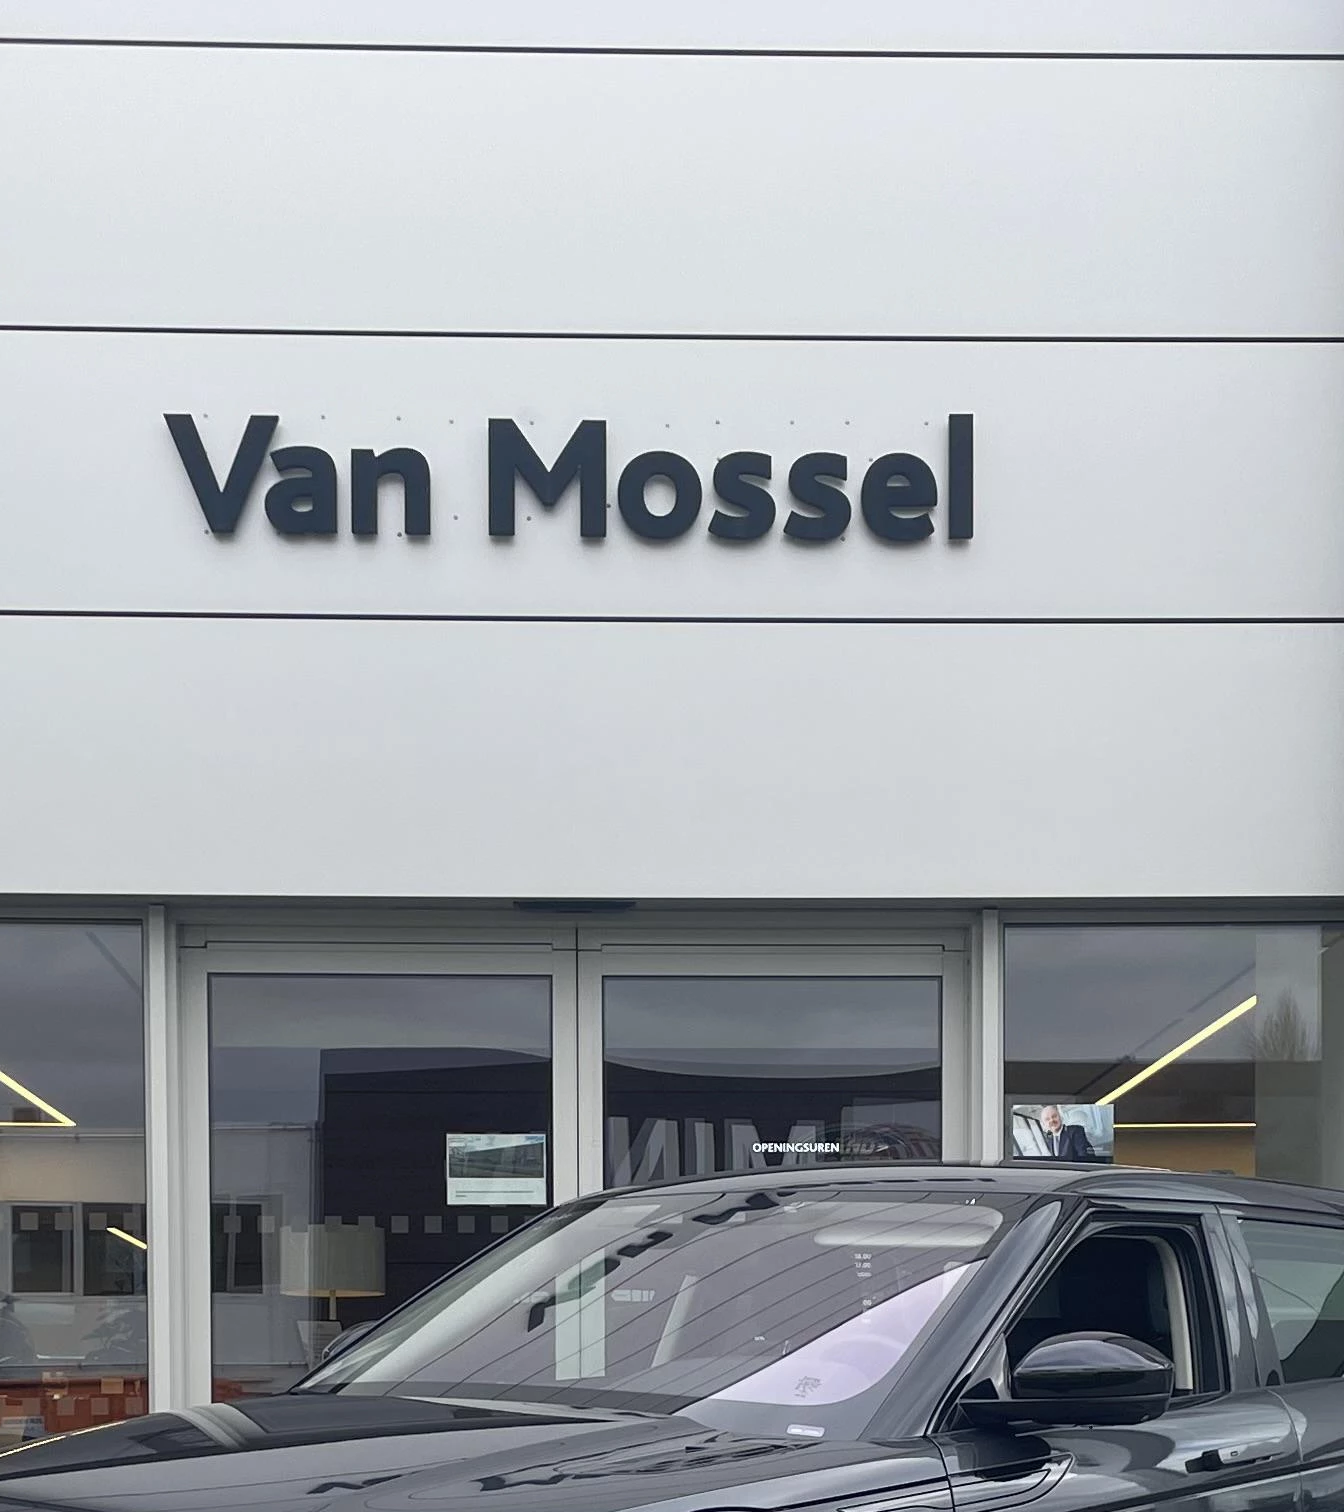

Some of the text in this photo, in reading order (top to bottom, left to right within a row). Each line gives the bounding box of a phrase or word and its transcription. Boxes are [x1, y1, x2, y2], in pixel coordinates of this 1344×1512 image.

[163, 413, 974, 544] Van Mossel
[752, 1142, 840, 1153] OPENINGSUREN
